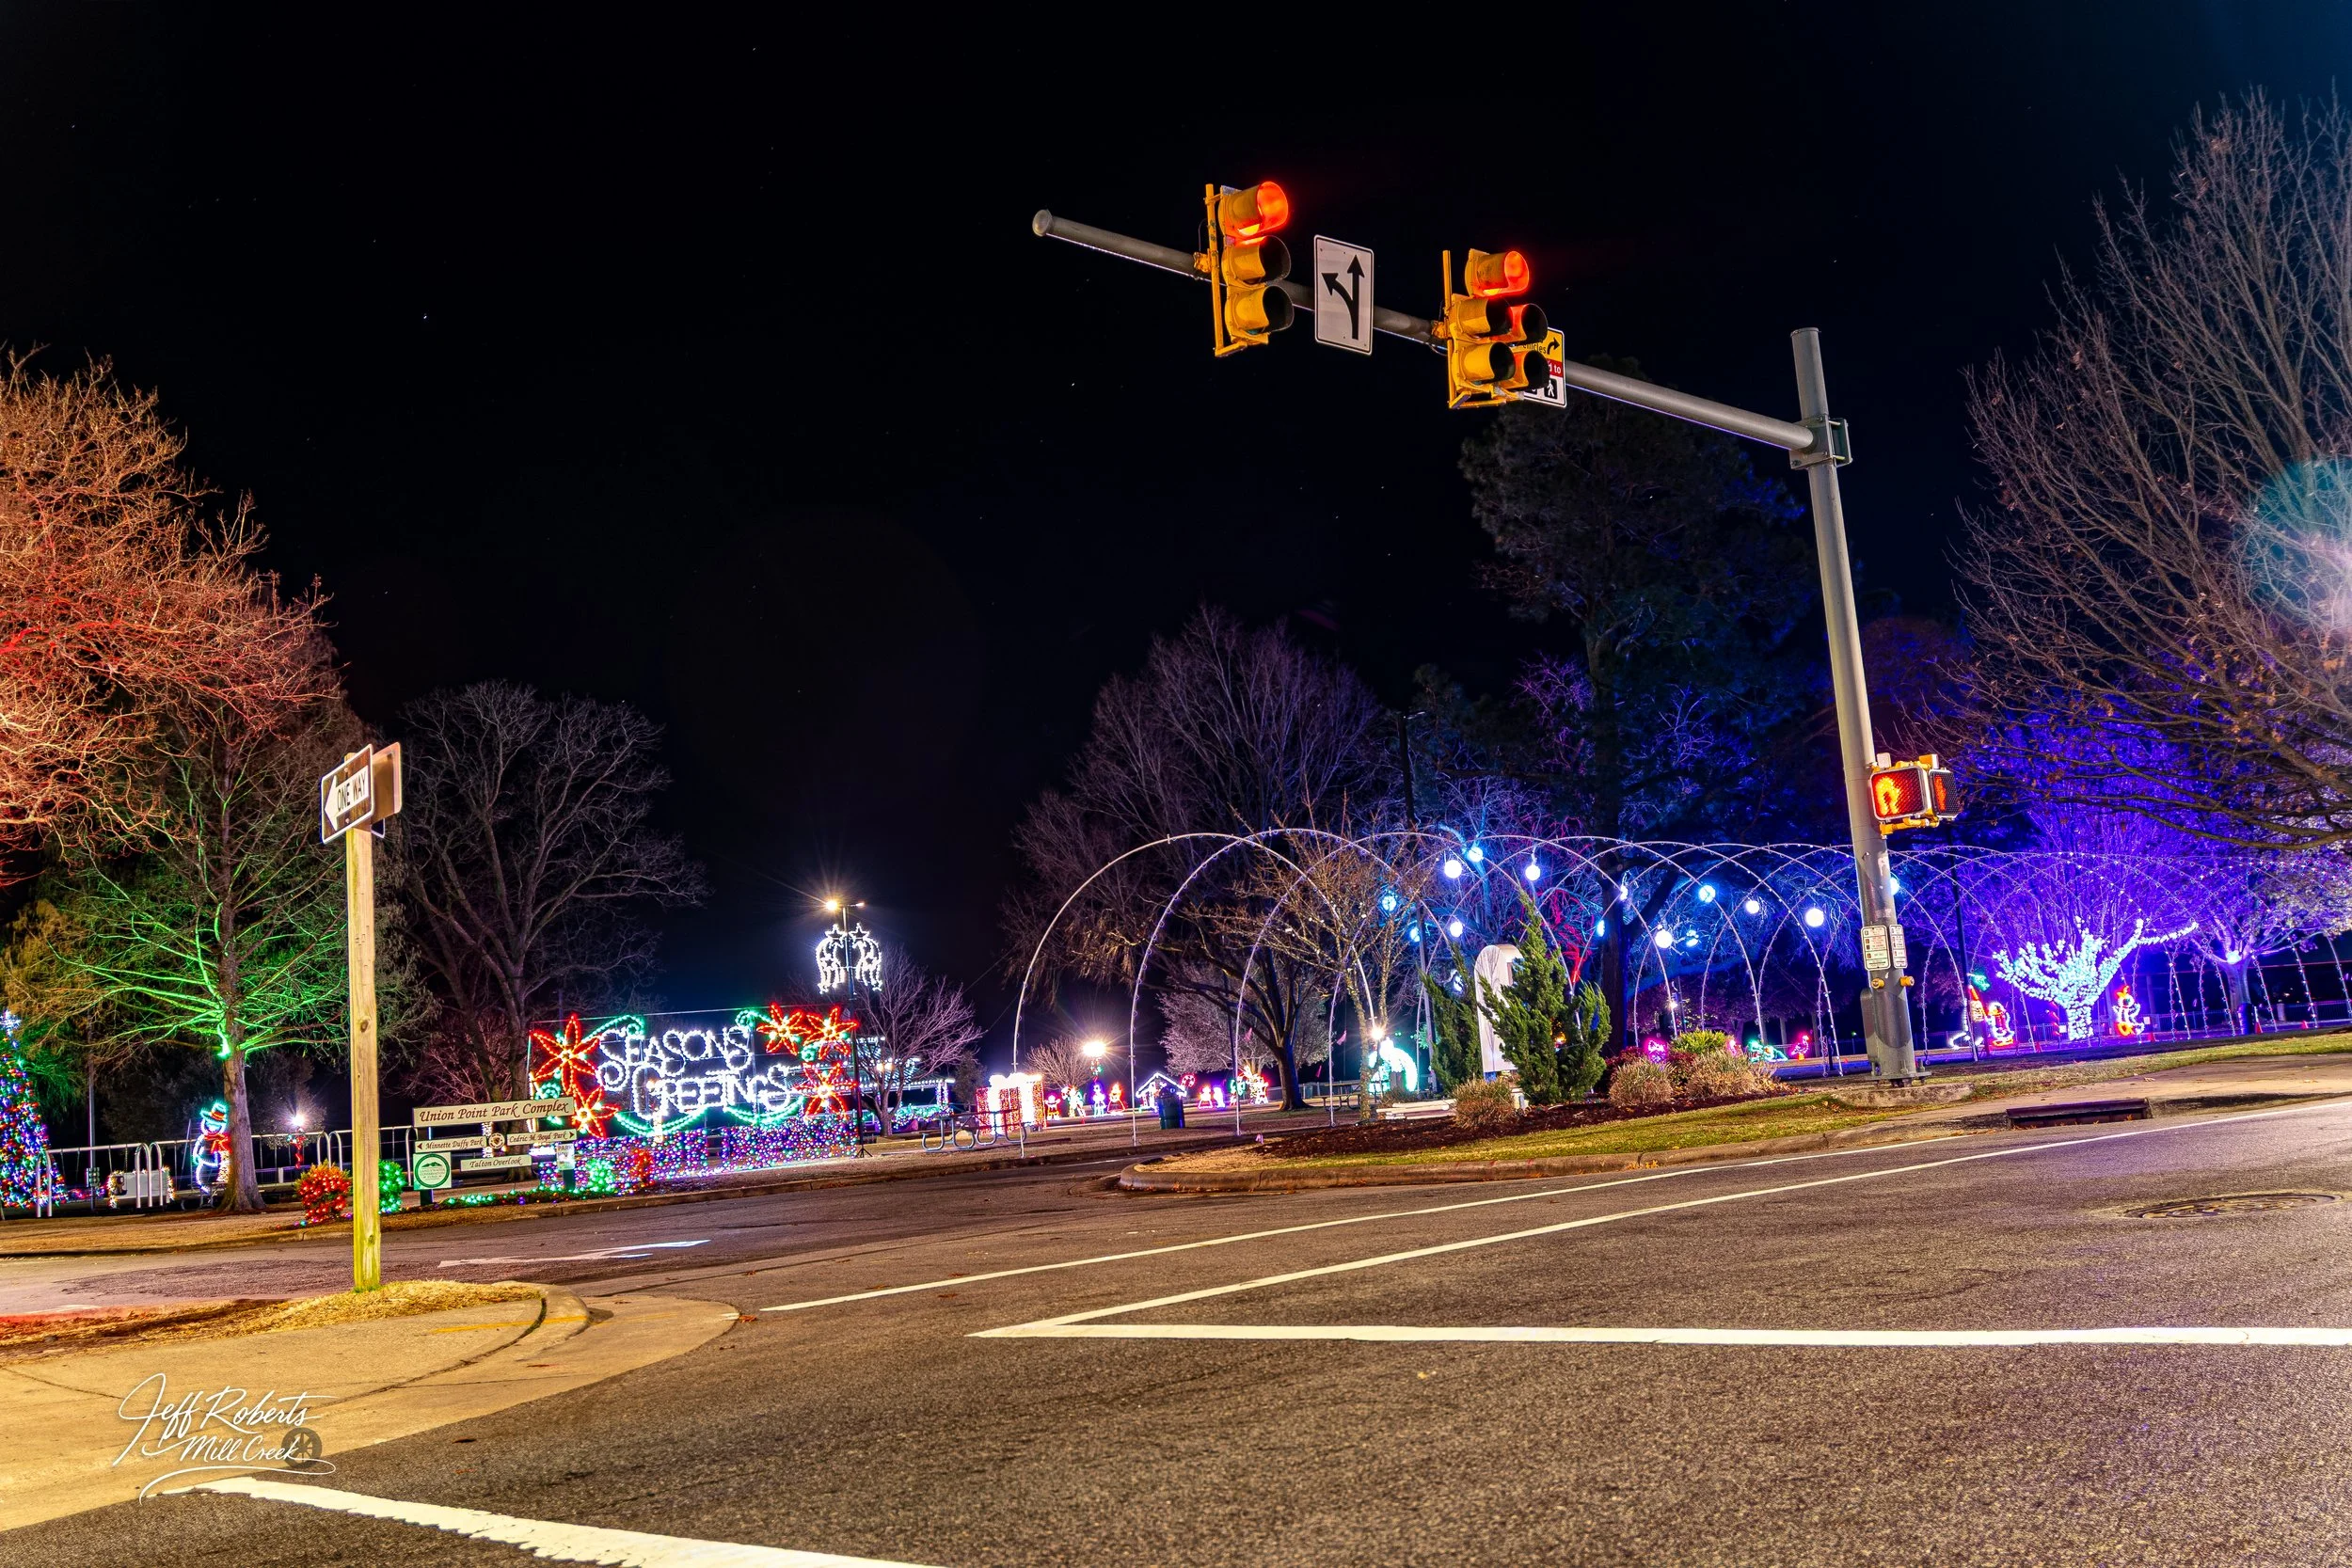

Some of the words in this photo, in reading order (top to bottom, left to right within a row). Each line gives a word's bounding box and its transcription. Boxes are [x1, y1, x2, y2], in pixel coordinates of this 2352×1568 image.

[1554, 364, 1562, 374] to
[337, 783, 350, 812] ONE
[352, 770, 366, 801] WAY
[596, 1026, 753, 1091] SEASONS
[420, 1110, 454, 1121] Union
[457, 1108, 487, 1119] Point
[491, 1103, 520, 1117] Park
[522, 1100, 569, 1116] Complex
[537, 1132, 551, 1141] Boyd
[553, 1131, 568, 1140] Park
[426, 1141, 451, 1149] Minnette
[452, 1139, 469, 1149] Duffy
[470, 1138, 485, 1147] Park
[469, 1160, 492, 1168] Talton
[493, 1157, 523, 1165] Overlook
